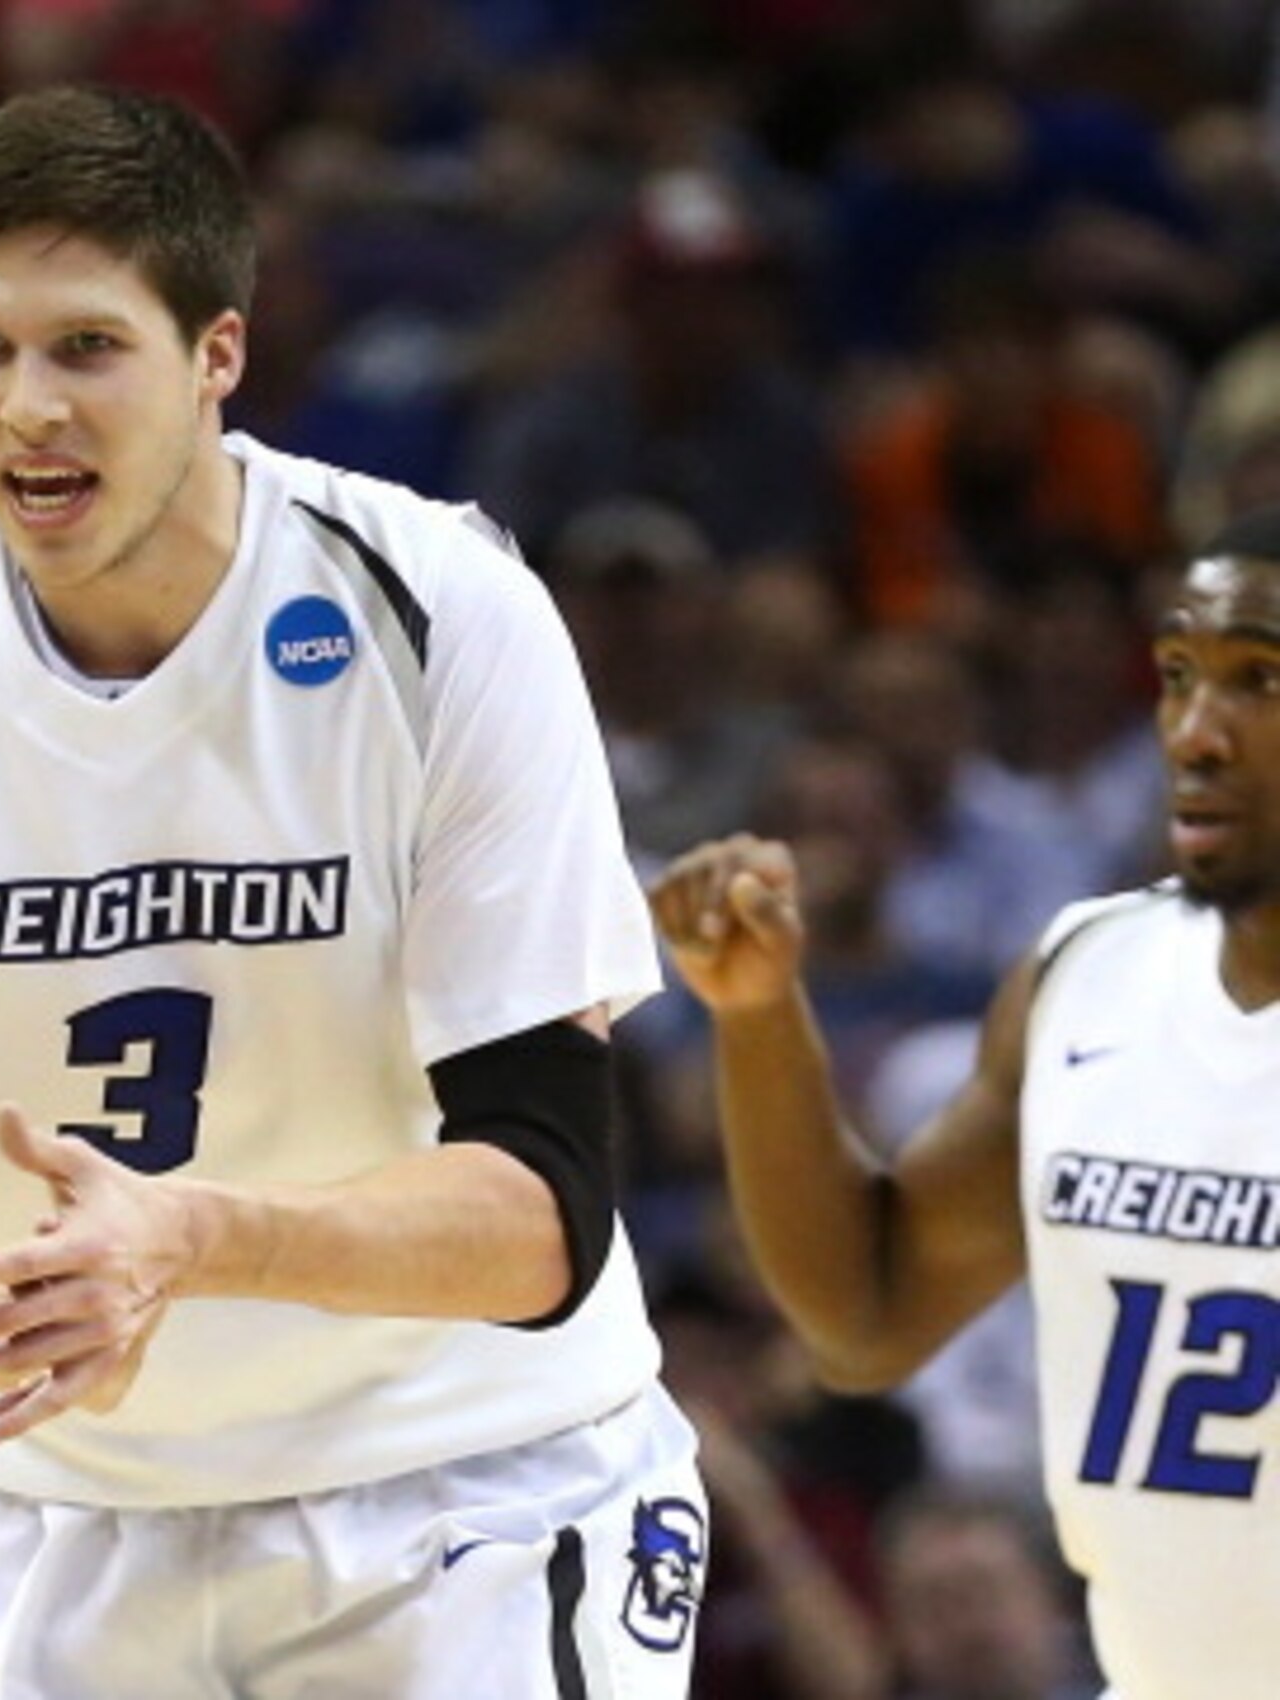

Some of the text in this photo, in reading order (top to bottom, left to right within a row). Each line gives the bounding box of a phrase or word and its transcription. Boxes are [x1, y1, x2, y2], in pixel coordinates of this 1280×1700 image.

[278, 636, 350, 666] NCAA
[57, 987, 213, 1175] 3
[1078, 1276, 1280, 1500] 12
